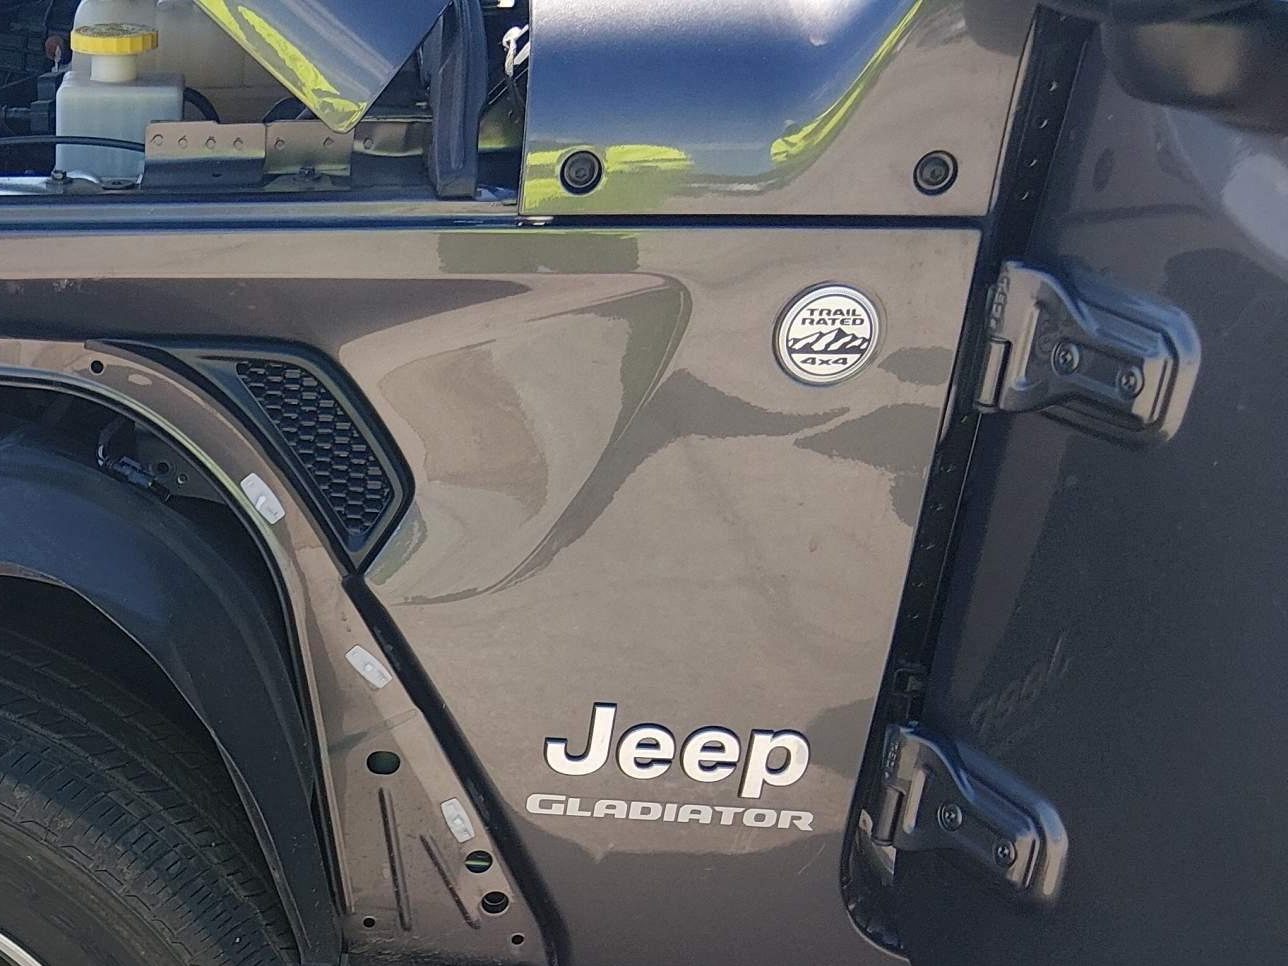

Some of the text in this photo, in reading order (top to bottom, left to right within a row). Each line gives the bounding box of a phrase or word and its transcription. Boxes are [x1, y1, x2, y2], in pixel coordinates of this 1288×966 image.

[807, 308, 862, 317] TRAIL
[801, 317, 865, 326] RATED
[800, 357, 849, 366] 4x4
[543, 701, 811, 799] Jeep
[525, 793, 814, 832] GLADIATOR
